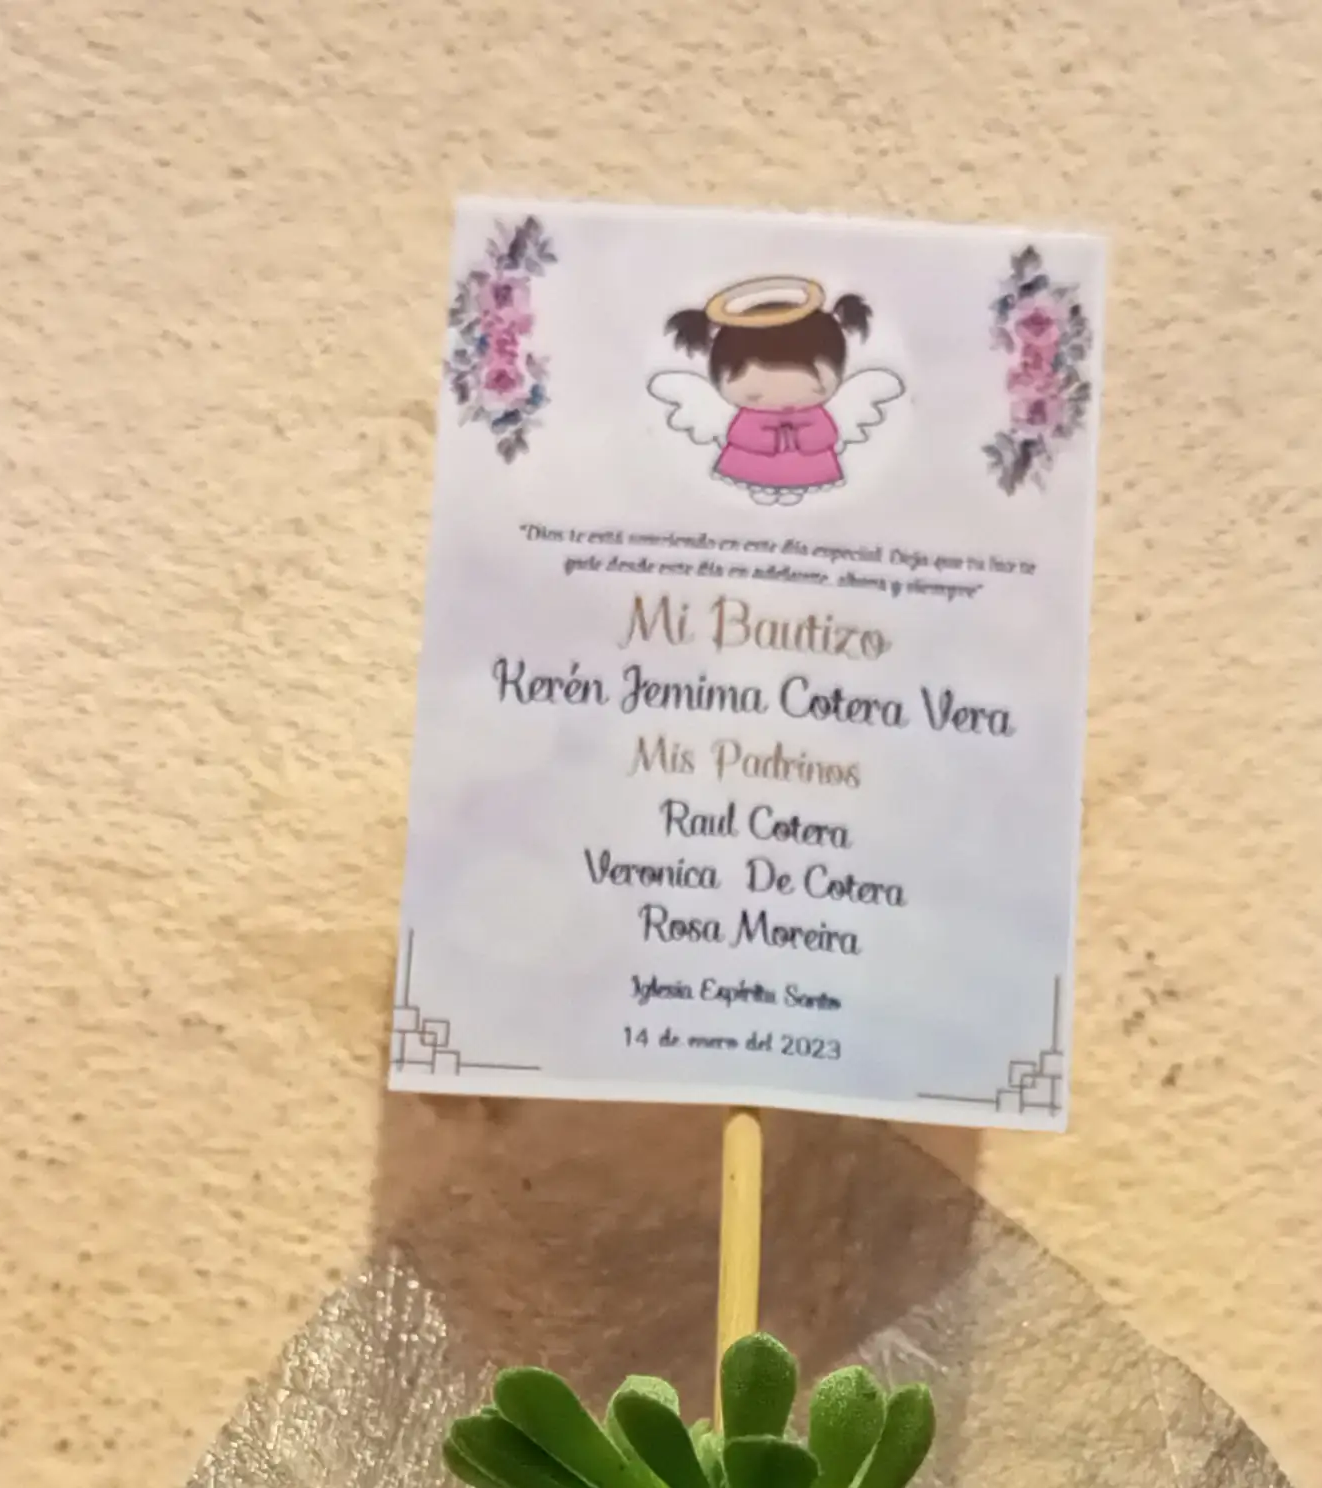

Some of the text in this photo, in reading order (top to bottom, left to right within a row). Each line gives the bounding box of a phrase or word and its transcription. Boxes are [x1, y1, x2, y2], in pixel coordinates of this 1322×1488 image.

[619, 594, 891, 660] Mi Bautizo
[493, 657, 1016, 738] Kerén Jemima Cotera Vera
[627, 736, 861, 789] Mis Padrinos
[660, 799, 853, 849] Raul Cotera
[584, 849, 907, 908] Veronica De Cotera
[637, 903, 861, 957] Rosa Moreira
[623, 1026, 649, 1047] 14
[659, 1027, 680, 1048] de
[745, 1031, 773, 1052] del
[780, 1035, 841, 1060] 2023
